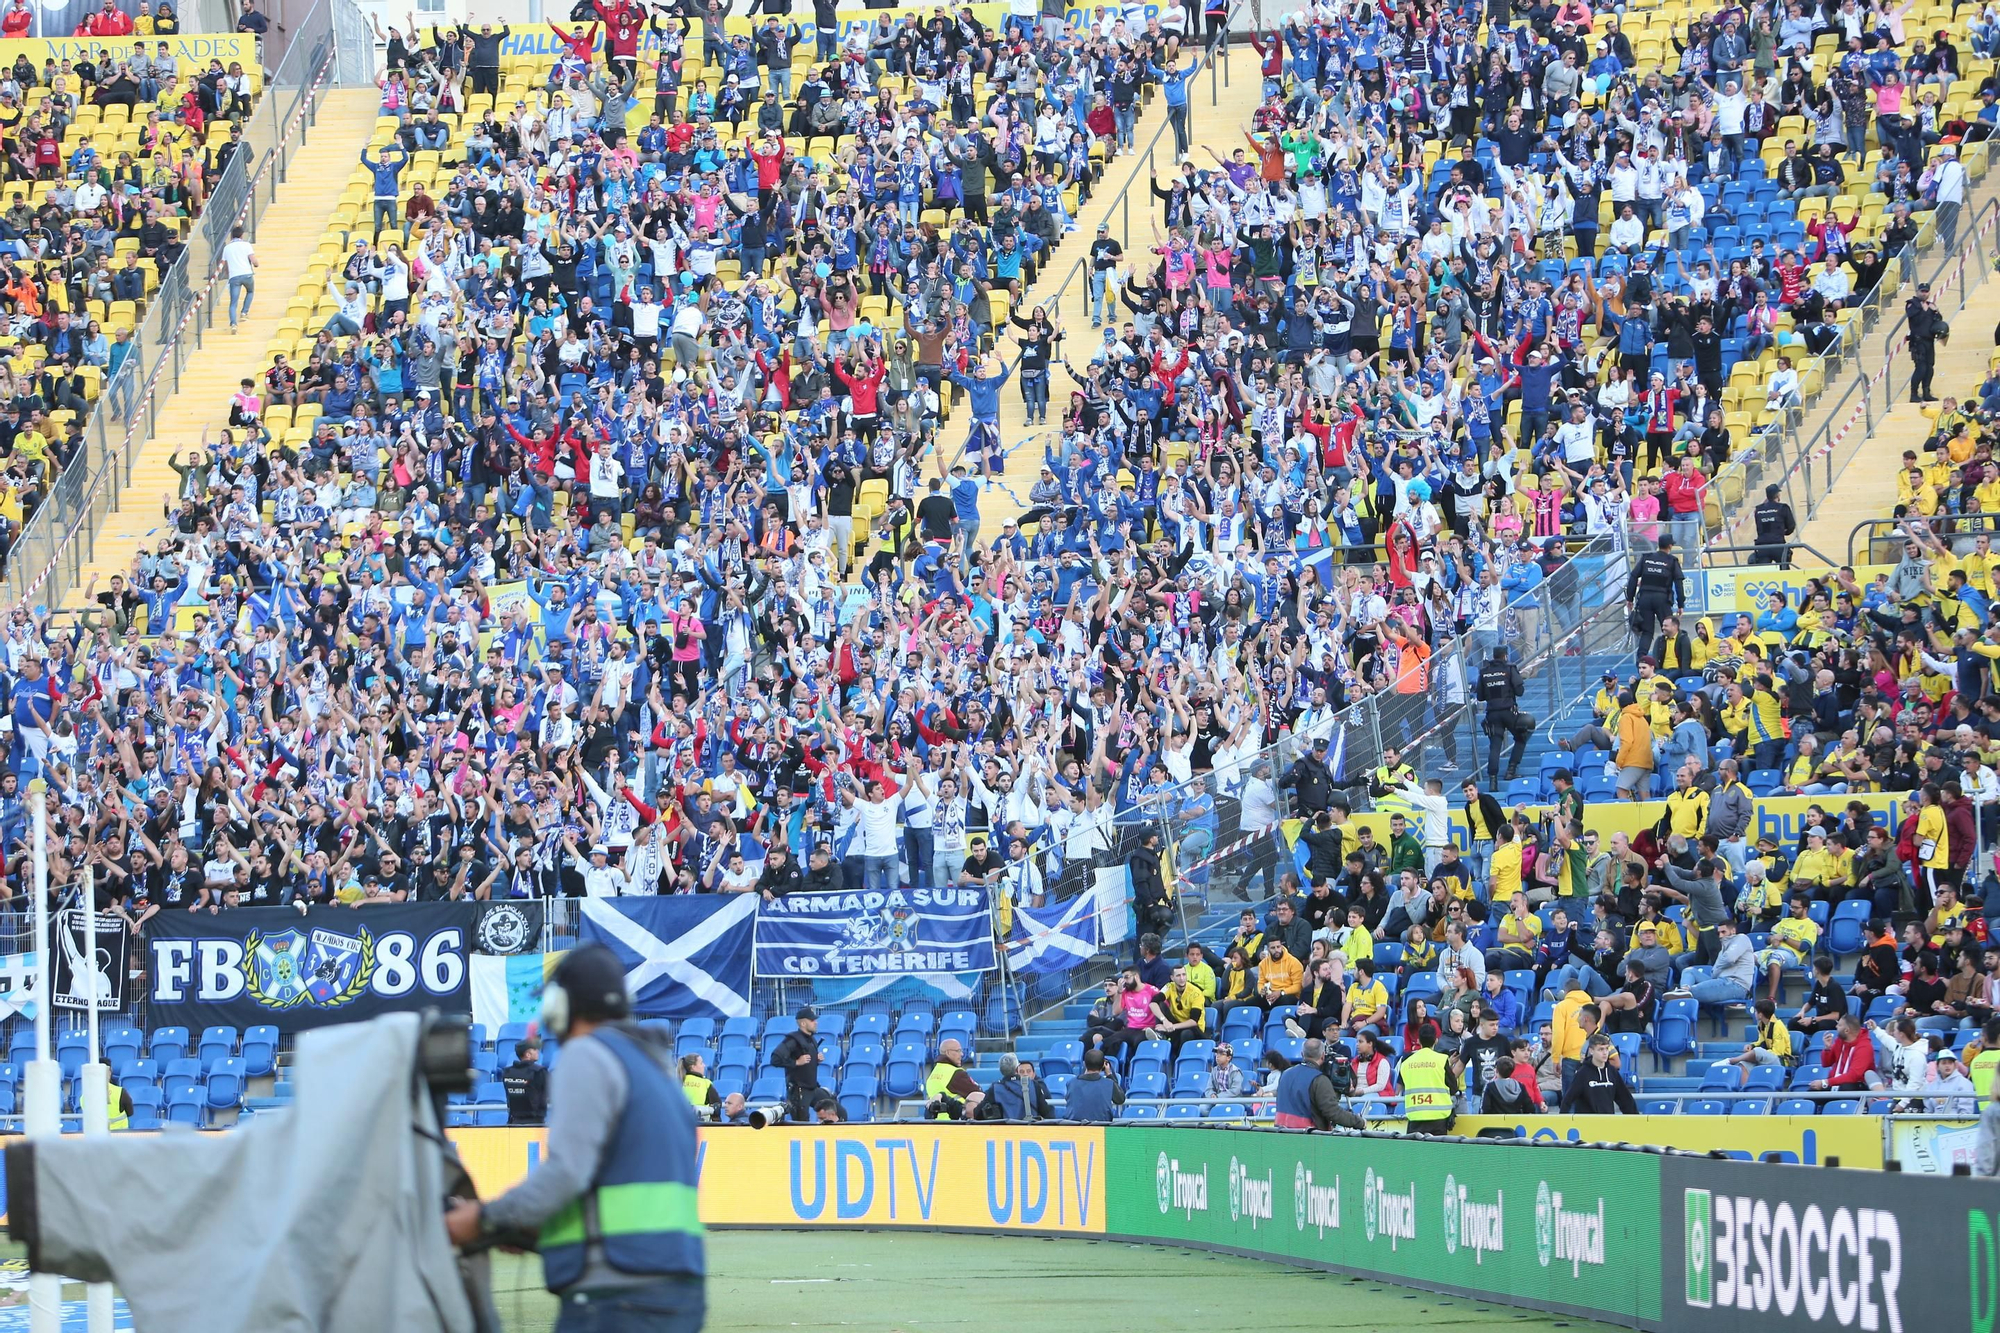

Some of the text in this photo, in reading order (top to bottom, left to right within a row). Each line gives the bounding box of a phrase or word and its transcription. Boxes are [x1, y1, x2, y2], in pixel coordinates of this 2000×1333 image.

[46, 40, 101, 61] MAR
[110, 46, 133, 60] DE
[1903, 566, 1924, 577] NIKE
[767, 888, 980, 913] ARMADA SUR
[151, 926, 465, 1002] FB 86
[783, 951, 970, 974] CD TENERIFE
[1410, 1094, 1433, 1105] 154
[789, 1138, 939, 1220] UDTV
[986, 1139, 1095, 1224] UDTV
[1170, 1159, 1208, 1221] Tropical
[1240, 1164, 1272, 1230] Tropical
[1305, 1170, 1340, 1240] Tropical
[1376, 1177, 1415, 1252] Tropical
[1458, 1184, 1503, 1265] Tropical
[1551, 1192, 1604, 1278] Tropical
[1715, 1194, 1903, 1333] BESOCCER
